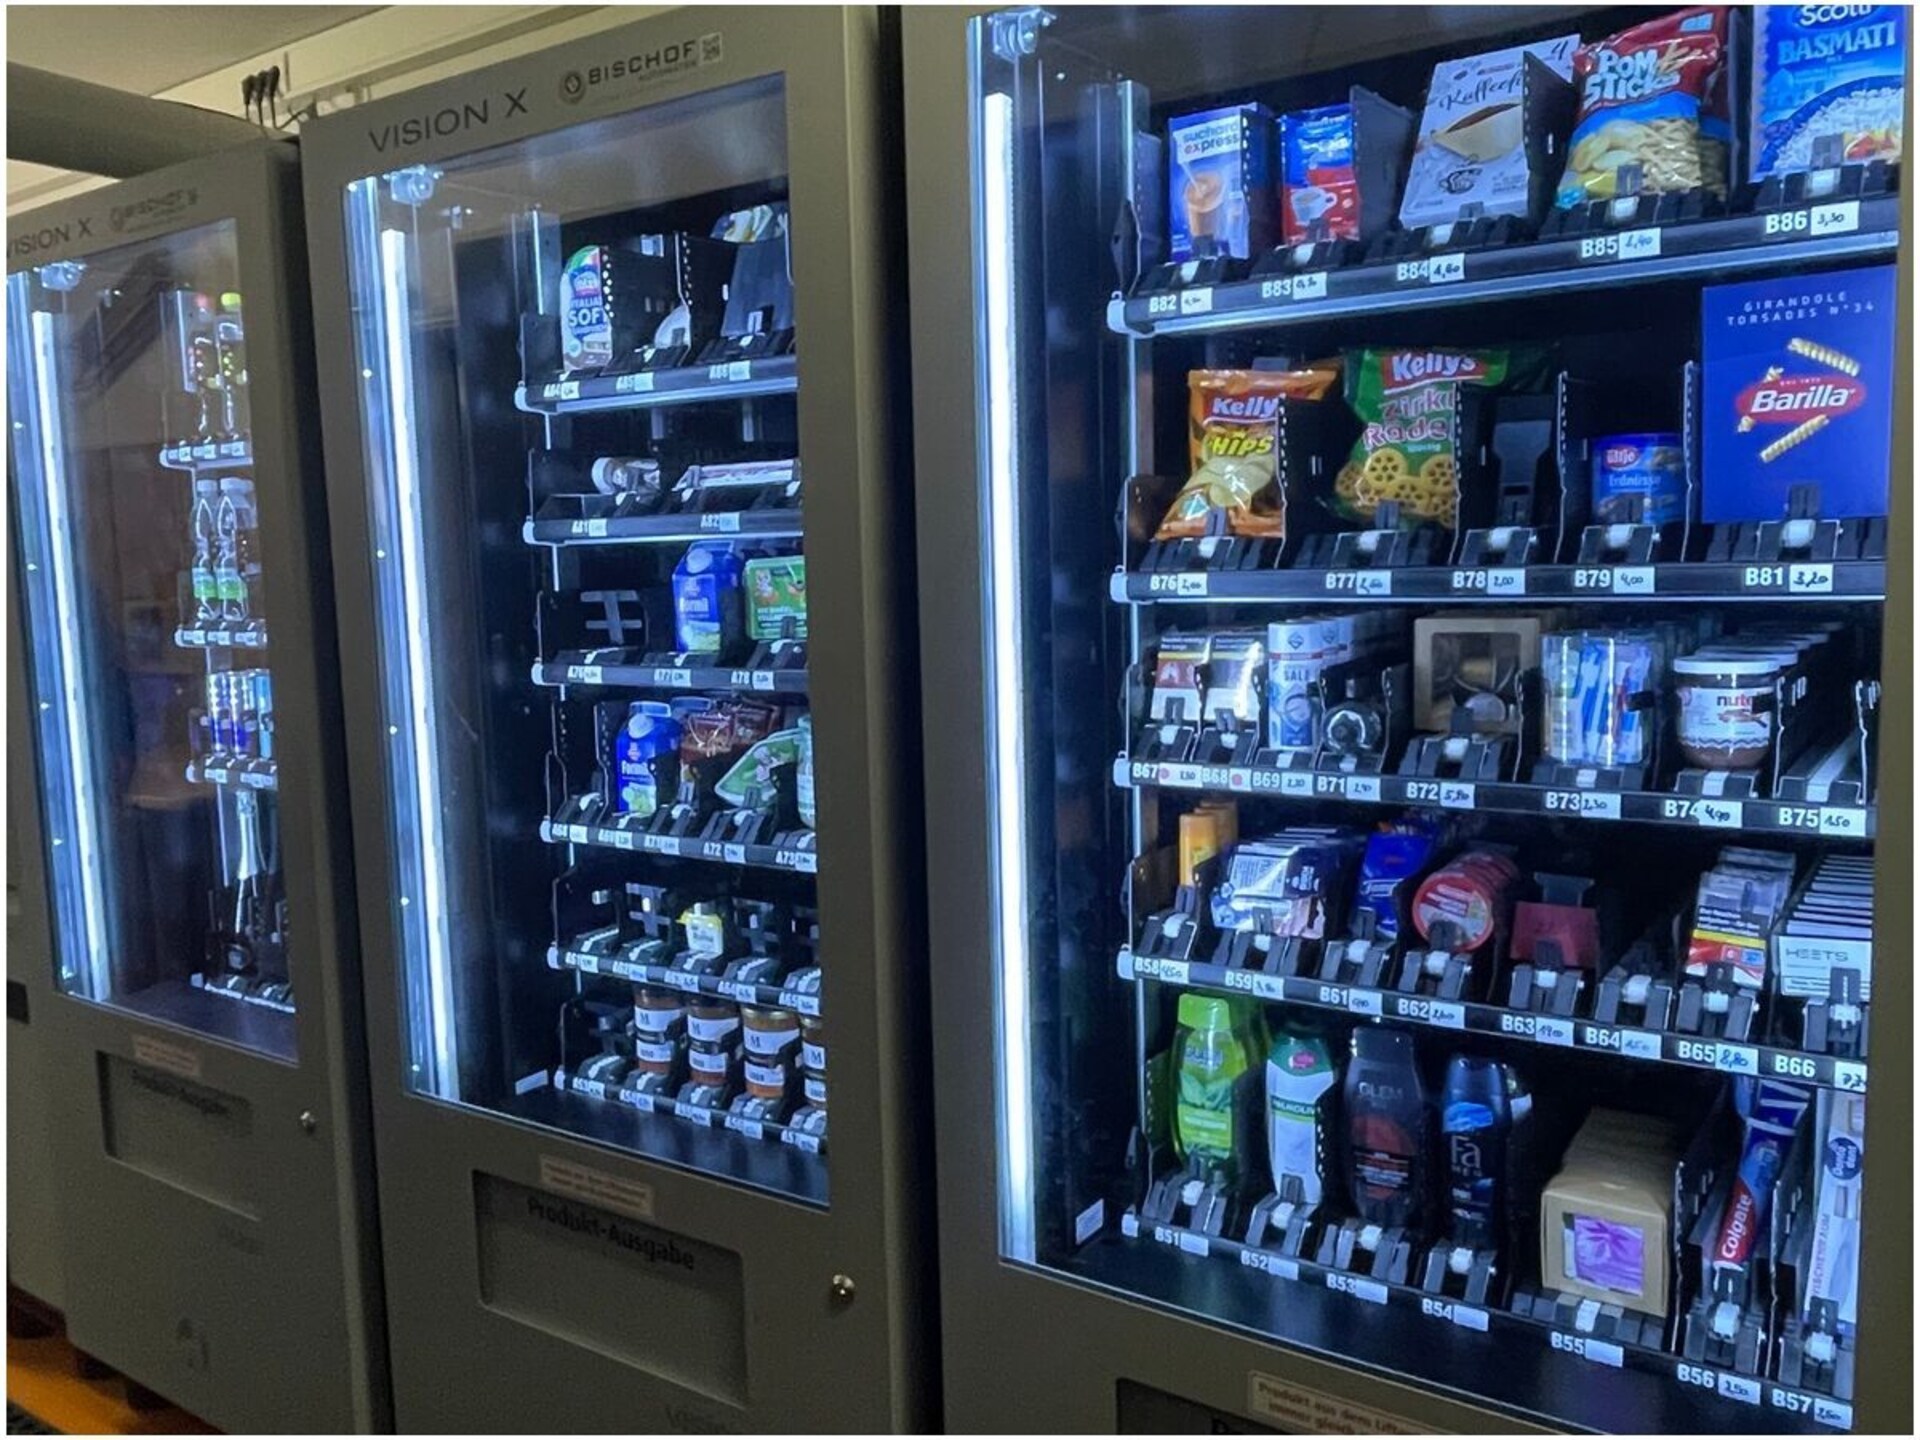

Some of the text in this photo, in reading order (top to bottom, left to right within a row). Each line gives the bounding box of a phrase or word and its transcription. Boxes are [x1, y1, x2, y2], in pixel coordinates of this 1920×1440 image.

[1778, 21, 1896, 65] BASMATI
[588, 40, 697, 86] BISCHOF
[1599, 49, 1658, 79] POM
[368, 88, 529, 152] VISION X
[1184, 133, 1240, 154] express
[78, 217, 92, 238] X
[1766, 211, 1808, 234] B86
[1581, 235, 1618, 258] B85
[1397, 262, 1430, 281] B84
[1262, 279, 1292, 298] B83
[1150, 295, 1177, 313] B82
[1744, 291, 1847, 313] GIRANDOLE
[1727, 307, 1818, 328] TORSADES
[1751, 384, 1855, 414] Barilla
[1208, 432, 1274, 456] HIPS
[1151, 575, 1178, 591] B76
[1326, 573, 1355, 589] B77
[1453, 571, 1486, 588] B78
[1574, 569, 1611, 587] B79
[1745, 567, 1784, 586] B81
[1132, 762, 1159, 778] B67
[1202, 768, 1228, 784] B68
[1252, 771, 1280, 788] B69
[1317, 776, 1345, 793] B71
[1406, 782, 1439, 800] B72
[1545, 792, 1580, 809] B73
[1779, 808, 1819, 827] B75
[703, 842, 722, 856] A72
[1134, 957, 1160, 974] B58
[1785, 948, 1850, 963] HEETS
[1225, 972, 1252, 989] B59
[1320, 986, 1347, 1003] B61
[1398, 998, 1429, 1018] B62
[1502, 1014, 1535, 1034] B63
[1585, 1027, 1620, 1048] B64
[1678, 1040, 1715, 1063] B65
[1775, 1055, 1816, 1077] B66
[1451, 1135, 1481, 1168] Fa
[527, 1196, 695, 1271] Produkt-Ausgabe
[1155, 1226, 1180, 1246] B51
[1722, 1195, 1753, 1259] Colgate
[1241, 1250, 1268, 1268] B52
[1326, 1273, 1356, 1293] B53
[1422, 1299, 1454, 1320] B54
[1551, 1330, 1585, 1355] B55
[1677, 1363, 1716, 1388] B56
[1772, 1388, 1811, 1413] B57
